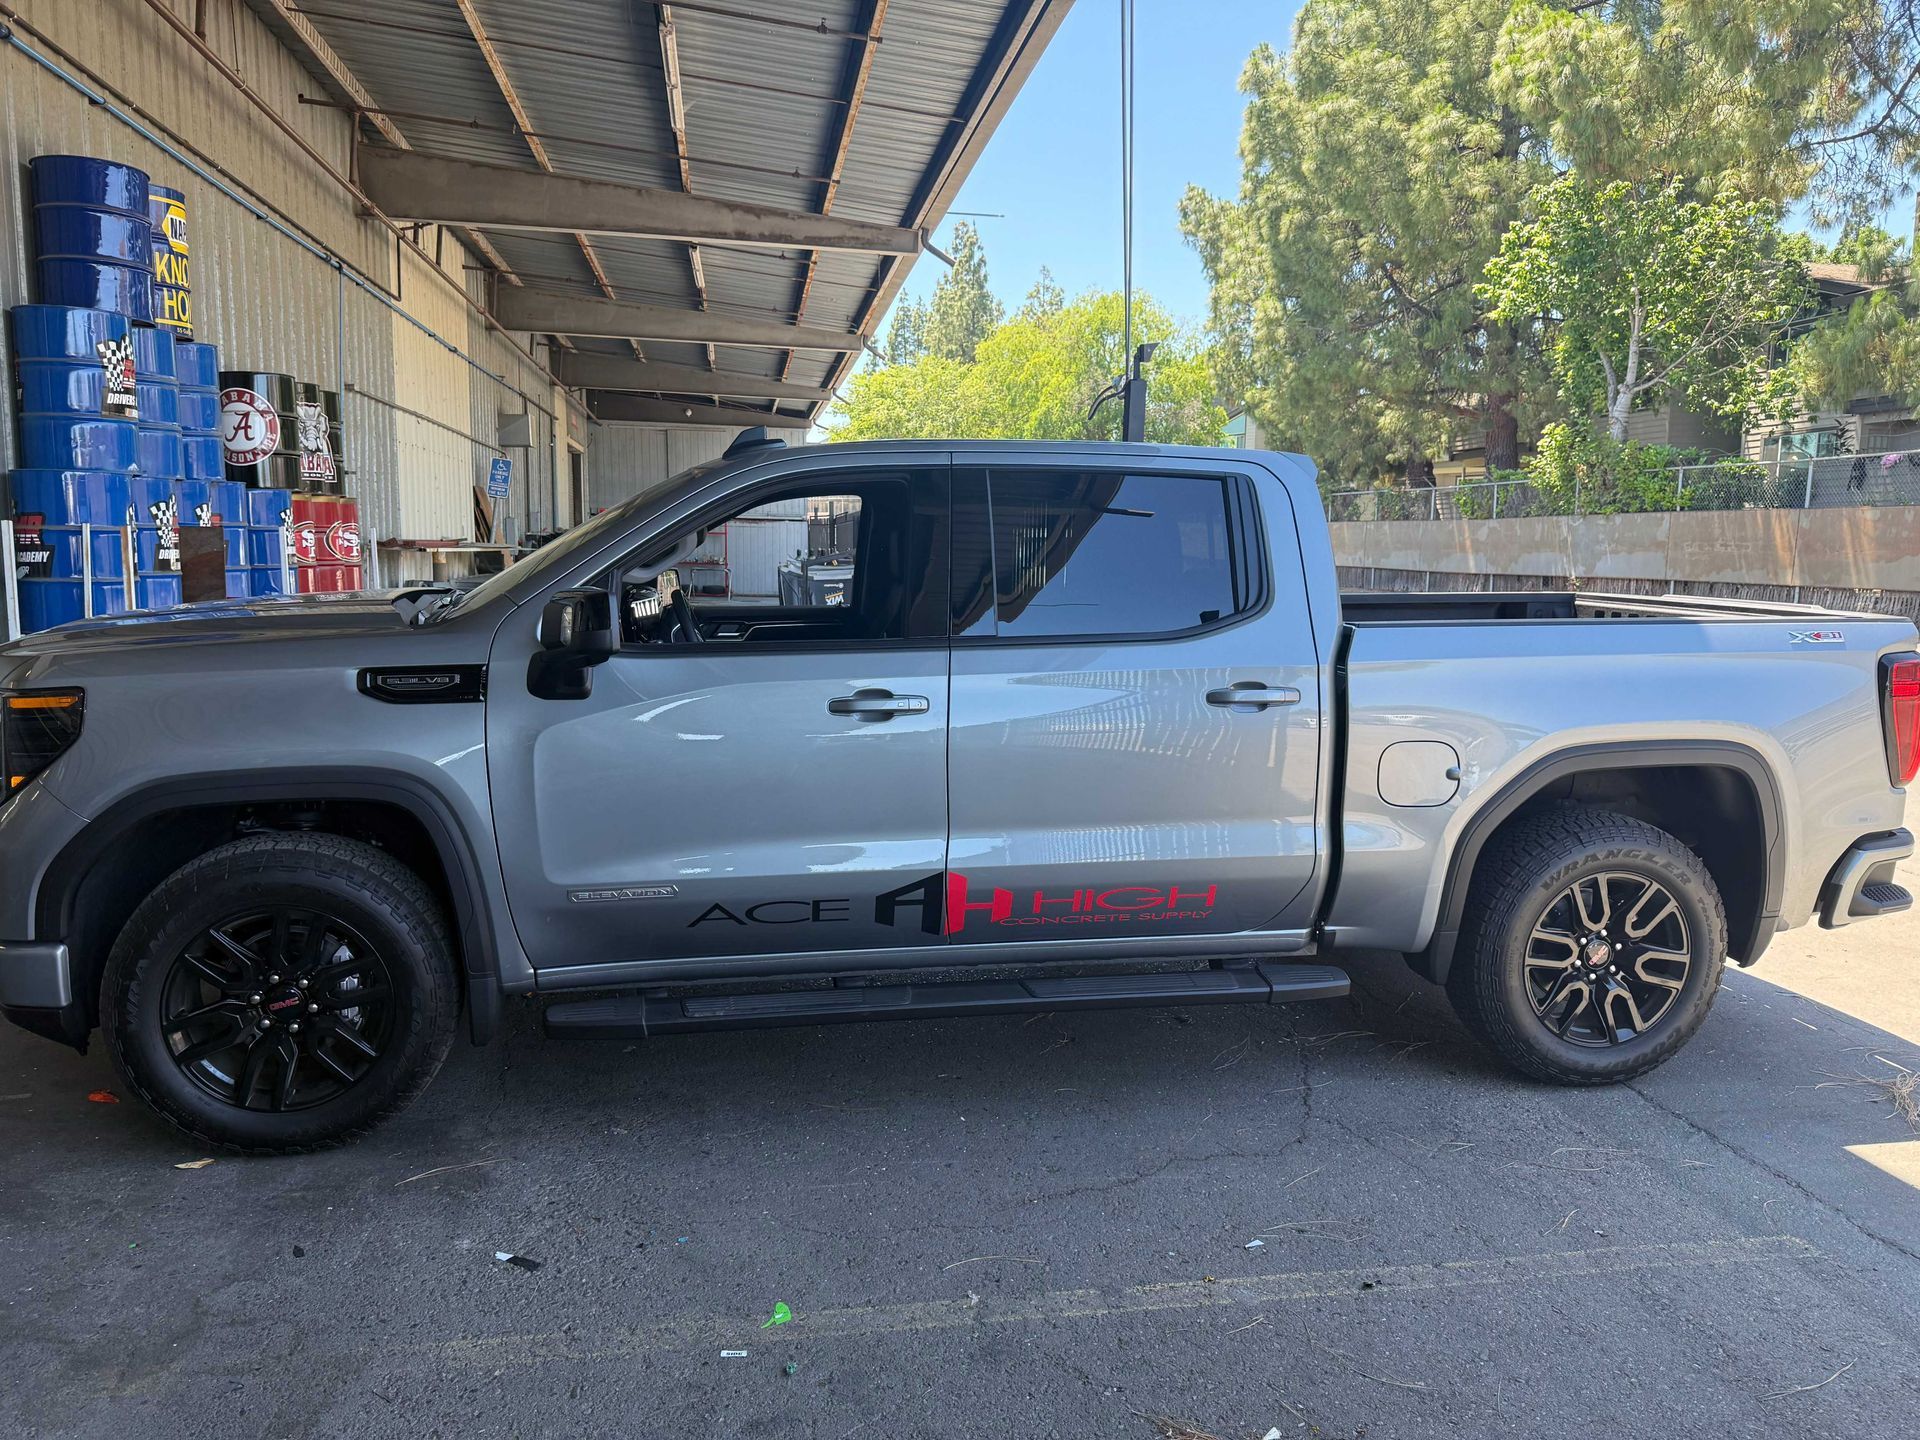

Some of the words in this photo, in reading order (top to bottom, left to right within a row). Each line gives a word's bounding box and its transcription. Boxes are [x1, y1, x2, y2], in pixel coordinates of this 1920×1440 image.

[225, 411, 255, 442] A
[1540, 848, 1692, 892] WRANGLER
[688, 899, 850, 928] ACE
[1033, 884, 1218, 915] HIGH
[1000, 912, 1130, 927] CONCRETE
[1137, 909, 1214, 922] SUPPLY
